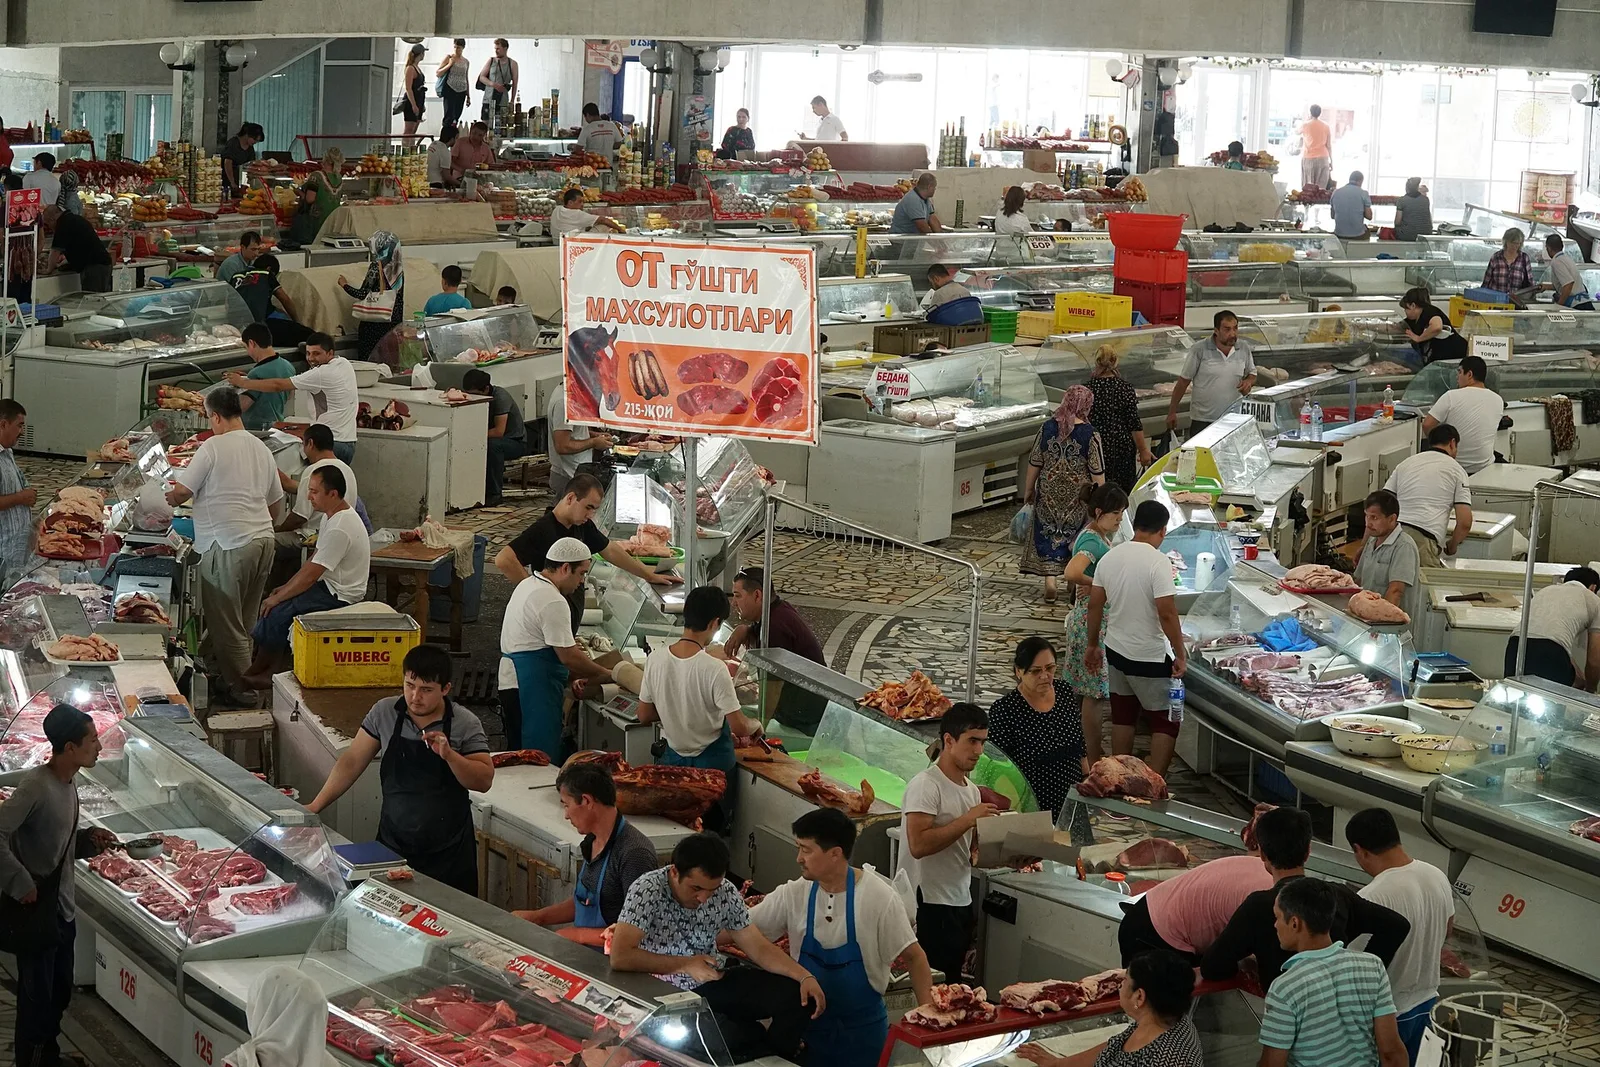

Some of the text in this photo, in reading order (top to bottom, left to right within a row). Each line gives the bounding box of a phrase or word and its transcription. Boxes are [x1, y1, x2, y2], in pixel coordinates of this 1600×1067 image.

[616, 249, 758, 294] ОТ ГЎШТИ
[586, 296, 793, 335] МАХСУЛОТЛАРИ
[1068, 307, 1096, 317] WIBERG
[1475, 339, 1507, 348] Жайдари
[876, 371, 909, 384] БЕДАНА
[624, 402, 673, 419] 215-ЖОЙ
[960, 480, 971, 496] 85
[333, 651, 391, 663] WIBERG
[1497, 894, 1526, 918] 99
[119, 967, 136, 1000] 126
[194, 1030, 213, 1066] 125
